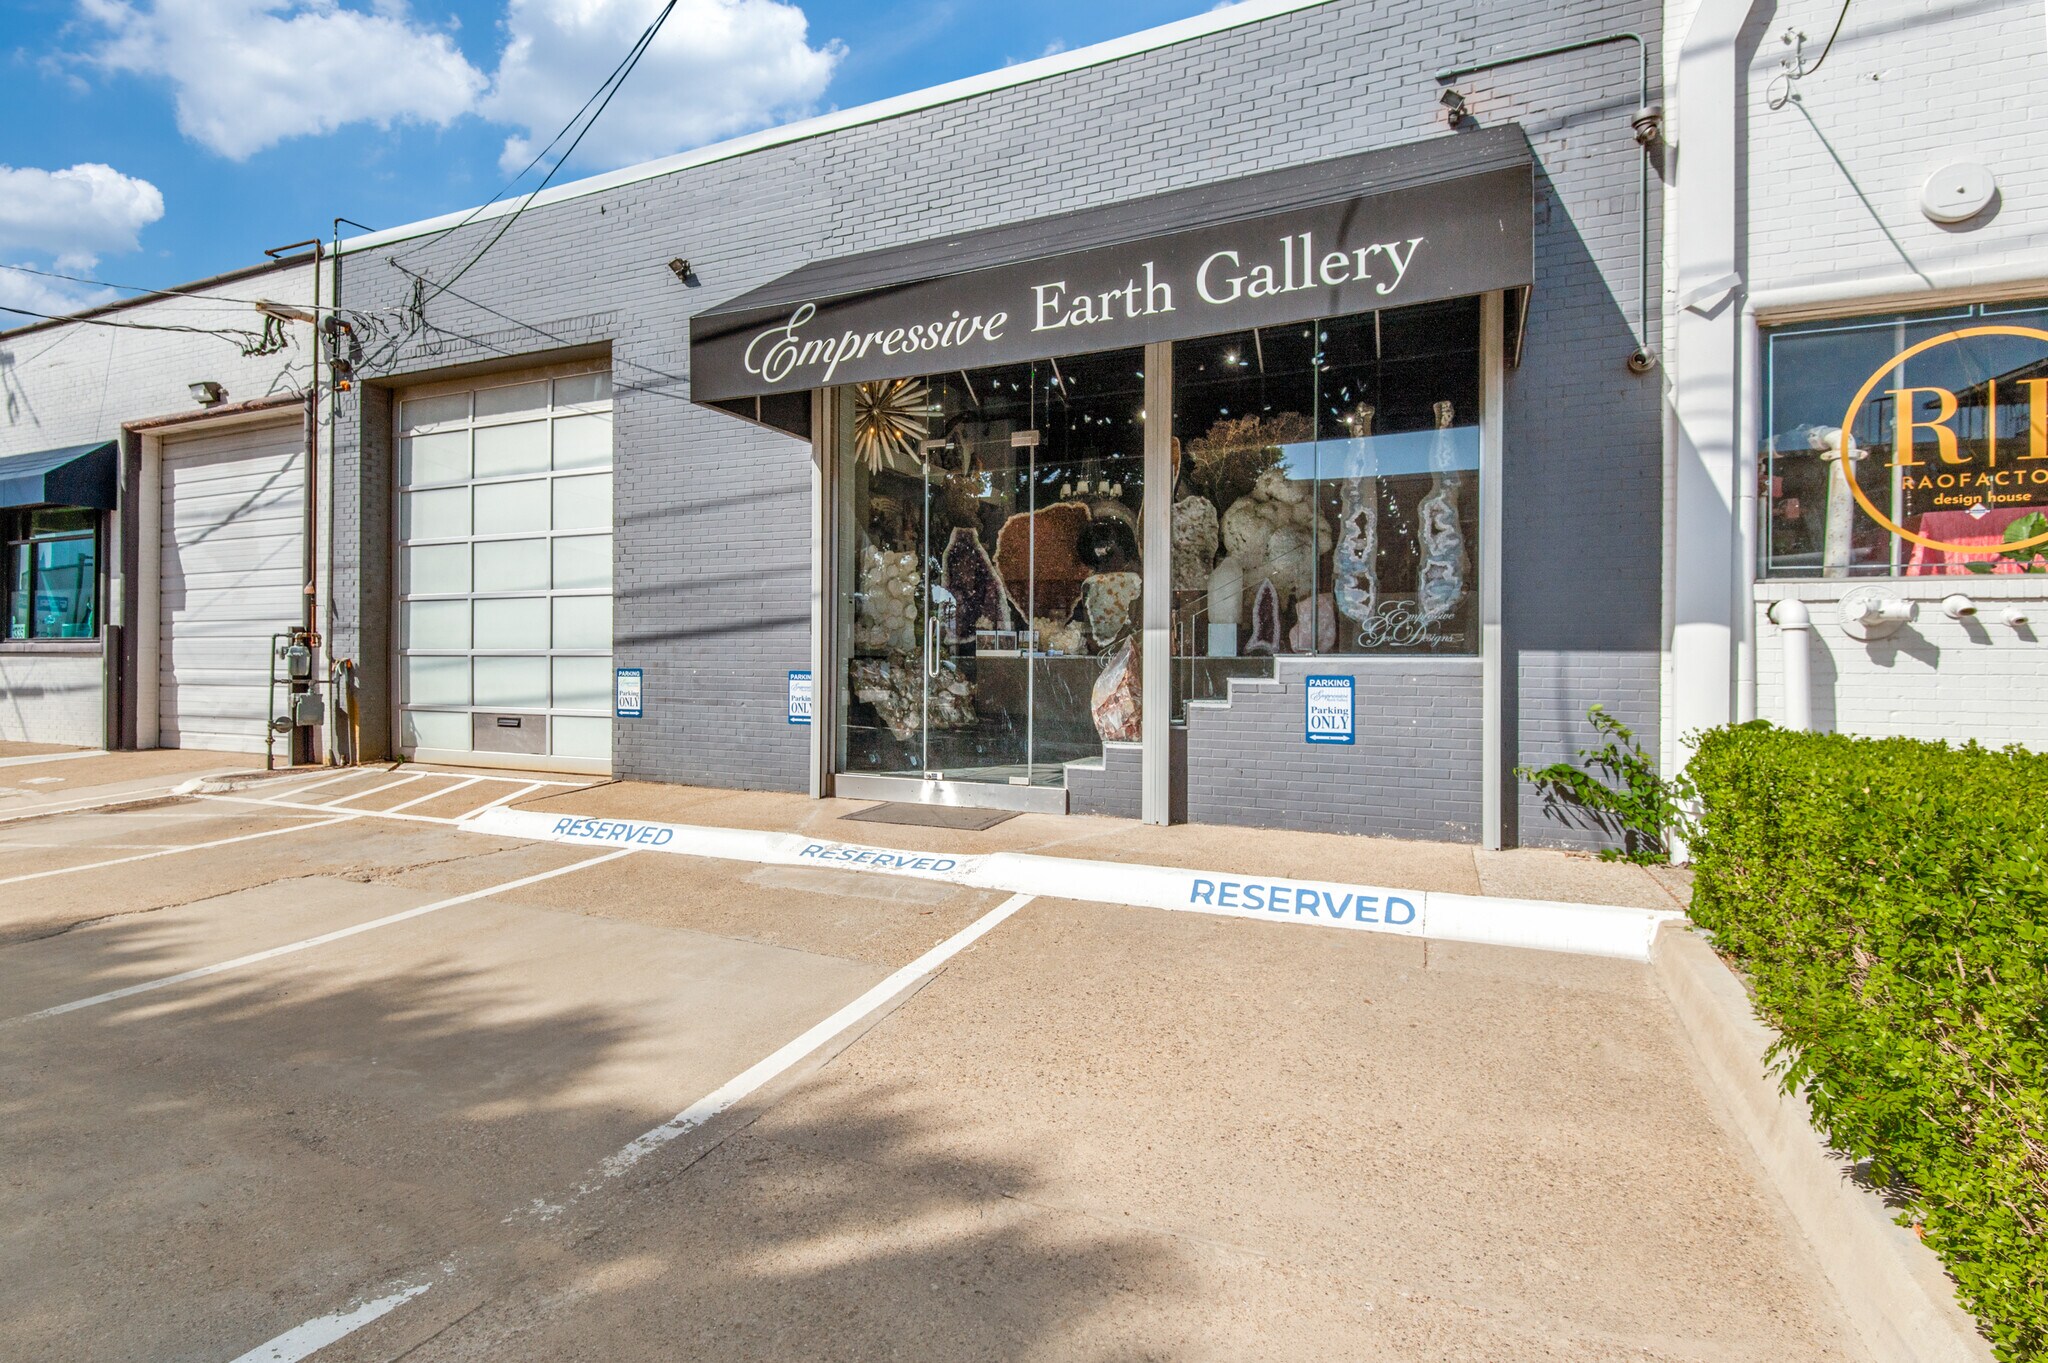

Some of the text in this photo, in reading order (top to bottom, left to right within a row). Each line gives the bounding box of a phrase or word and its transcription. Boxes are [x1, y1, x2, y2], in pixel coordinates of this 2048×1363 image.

[744, 232, 1424, 383] Empressive Earth Gallery
[1933, 490, 2032, 506] design house
[1309, 679, 1350, 687] PARKING
[619, 696, 640, 707] ONLY
[1311, 706, 1349, 715] Parking
[1311, 715, 1349, 729] ONLY
[552, 818, 674, 846] RESERVED
[799, 844, 957, 872] RESERVED
[1189, 879, 1416, 925] RESERVED
